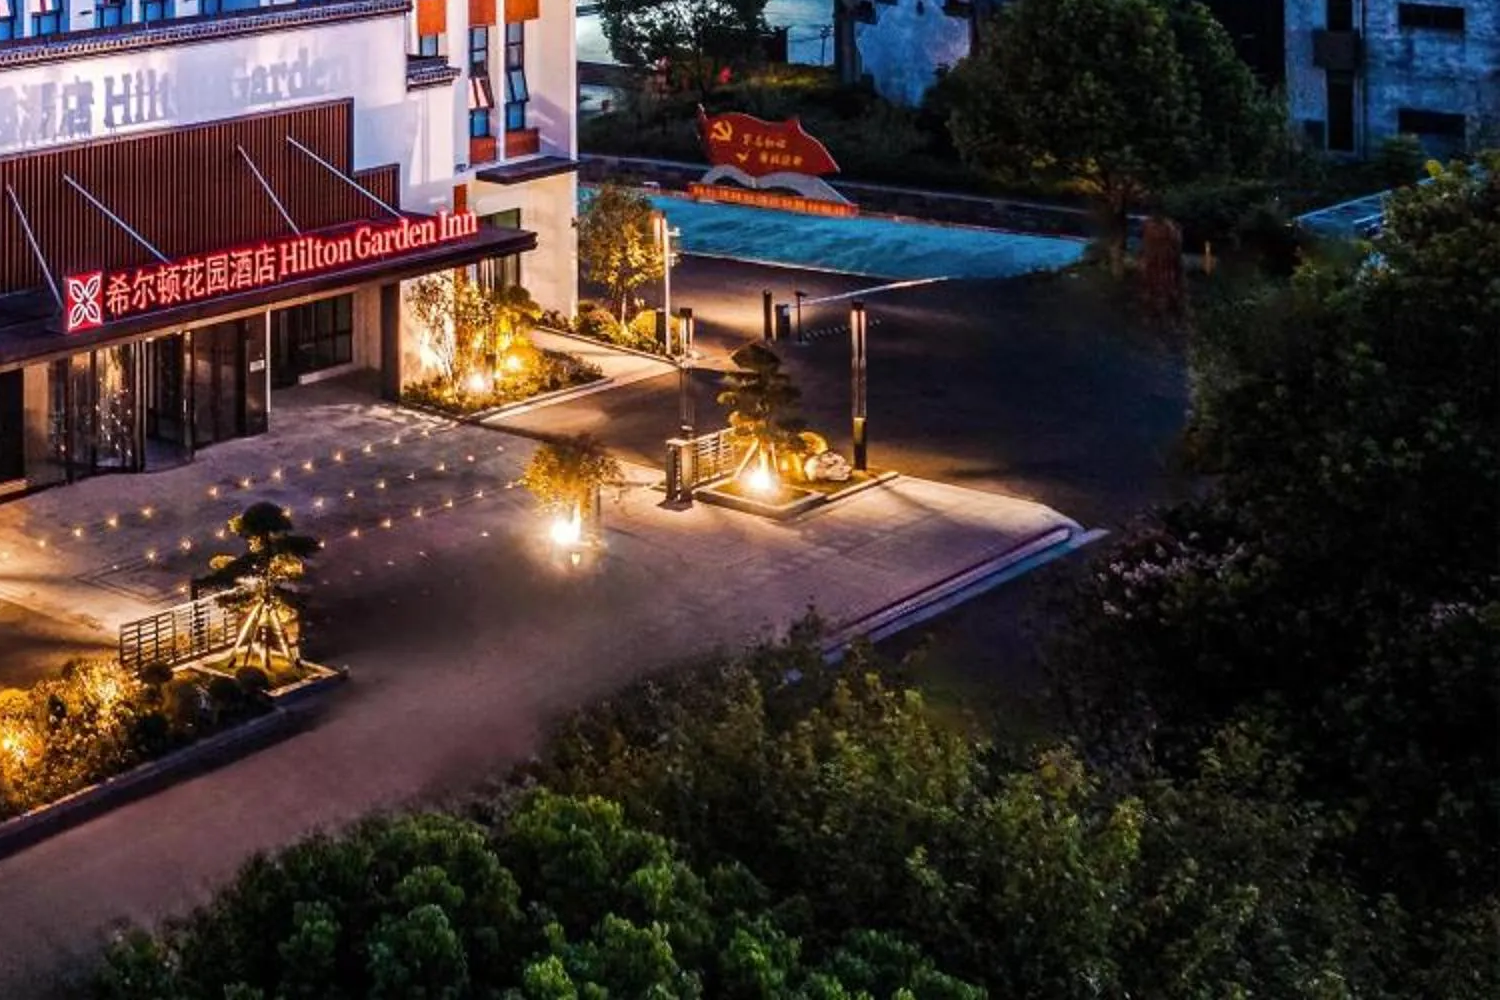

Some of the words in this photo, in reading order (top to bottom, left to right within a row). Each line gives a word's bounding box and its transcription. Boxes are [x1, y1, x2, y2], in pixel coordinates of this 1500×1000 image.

[105, 243, 276, 315] 希尔顿花园酒店
[280, 236, 352, 276] Hilton
[355, 218, 436, 260] Garden
[438, 209, 478, 241] Inn
